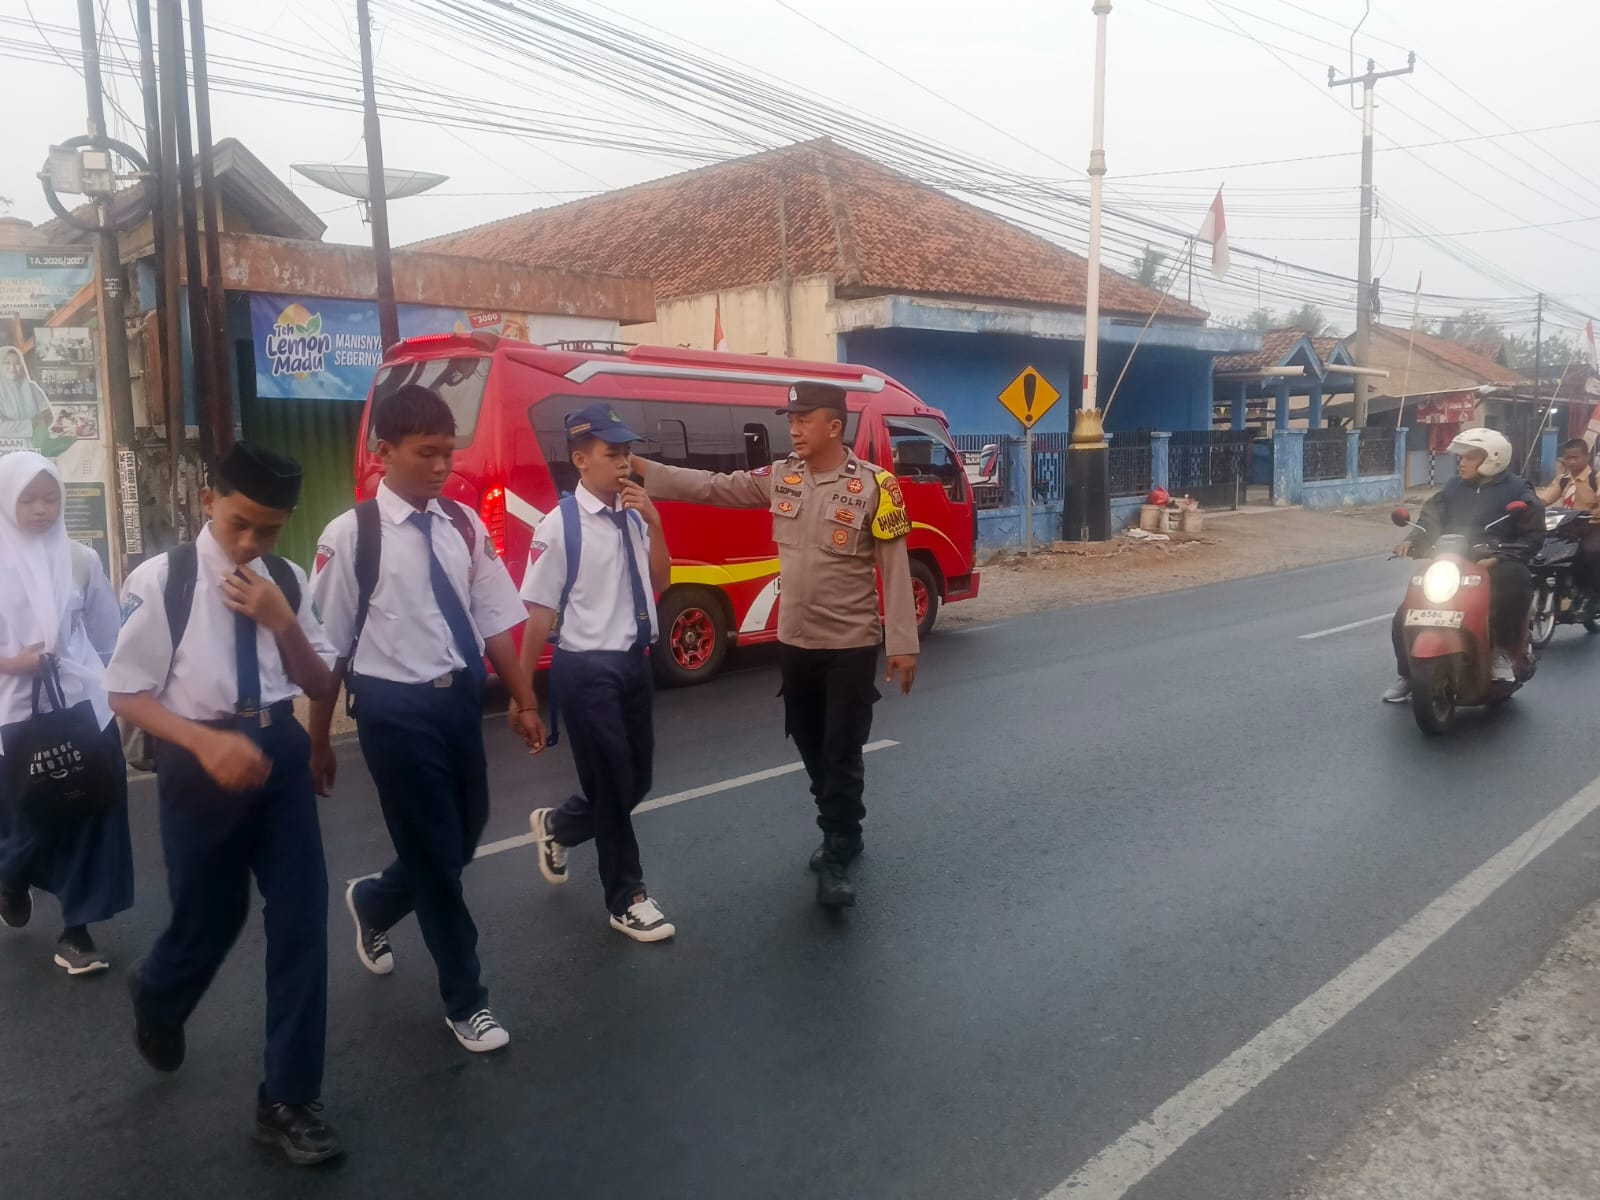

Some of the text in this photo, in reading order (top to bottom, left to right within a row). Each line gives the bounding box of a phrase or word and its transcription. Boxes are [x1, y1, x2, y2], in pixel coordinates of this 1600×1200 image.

[274, 323, 295, 336] Teh
[266, 334, 331, 358] Lemon
[272, 352, 324, 376] Madu
[334, 350, 384, 367] SEGERNYA
[832, 494, 867, 509] POLRI
